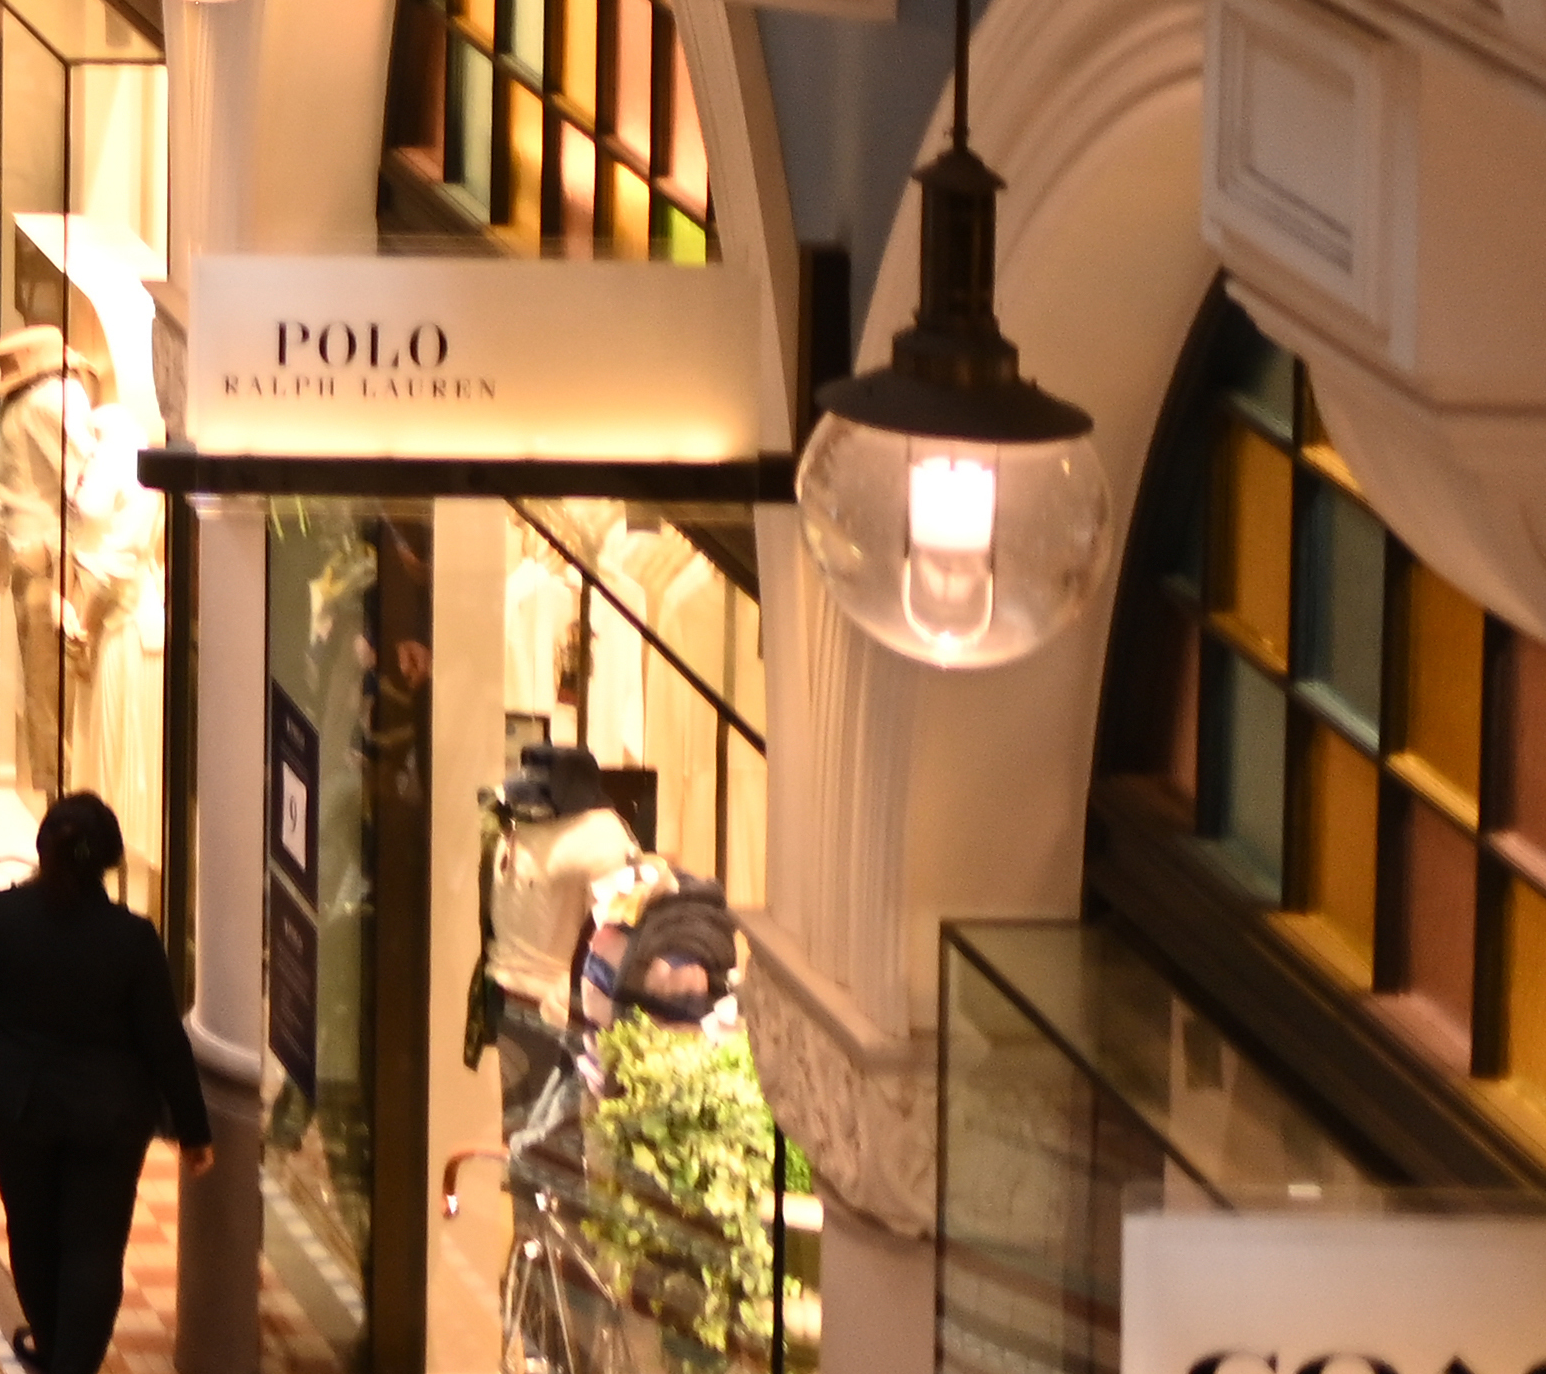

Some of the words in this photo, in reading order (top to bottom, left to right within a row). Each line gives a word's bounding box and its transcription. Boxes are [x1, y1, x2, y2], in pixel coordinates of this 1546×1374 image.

[276, 320, 449, 369] POLO
[223, 375, 335, 397] RALPH
[362, 377, 496, 400] LAUREN
